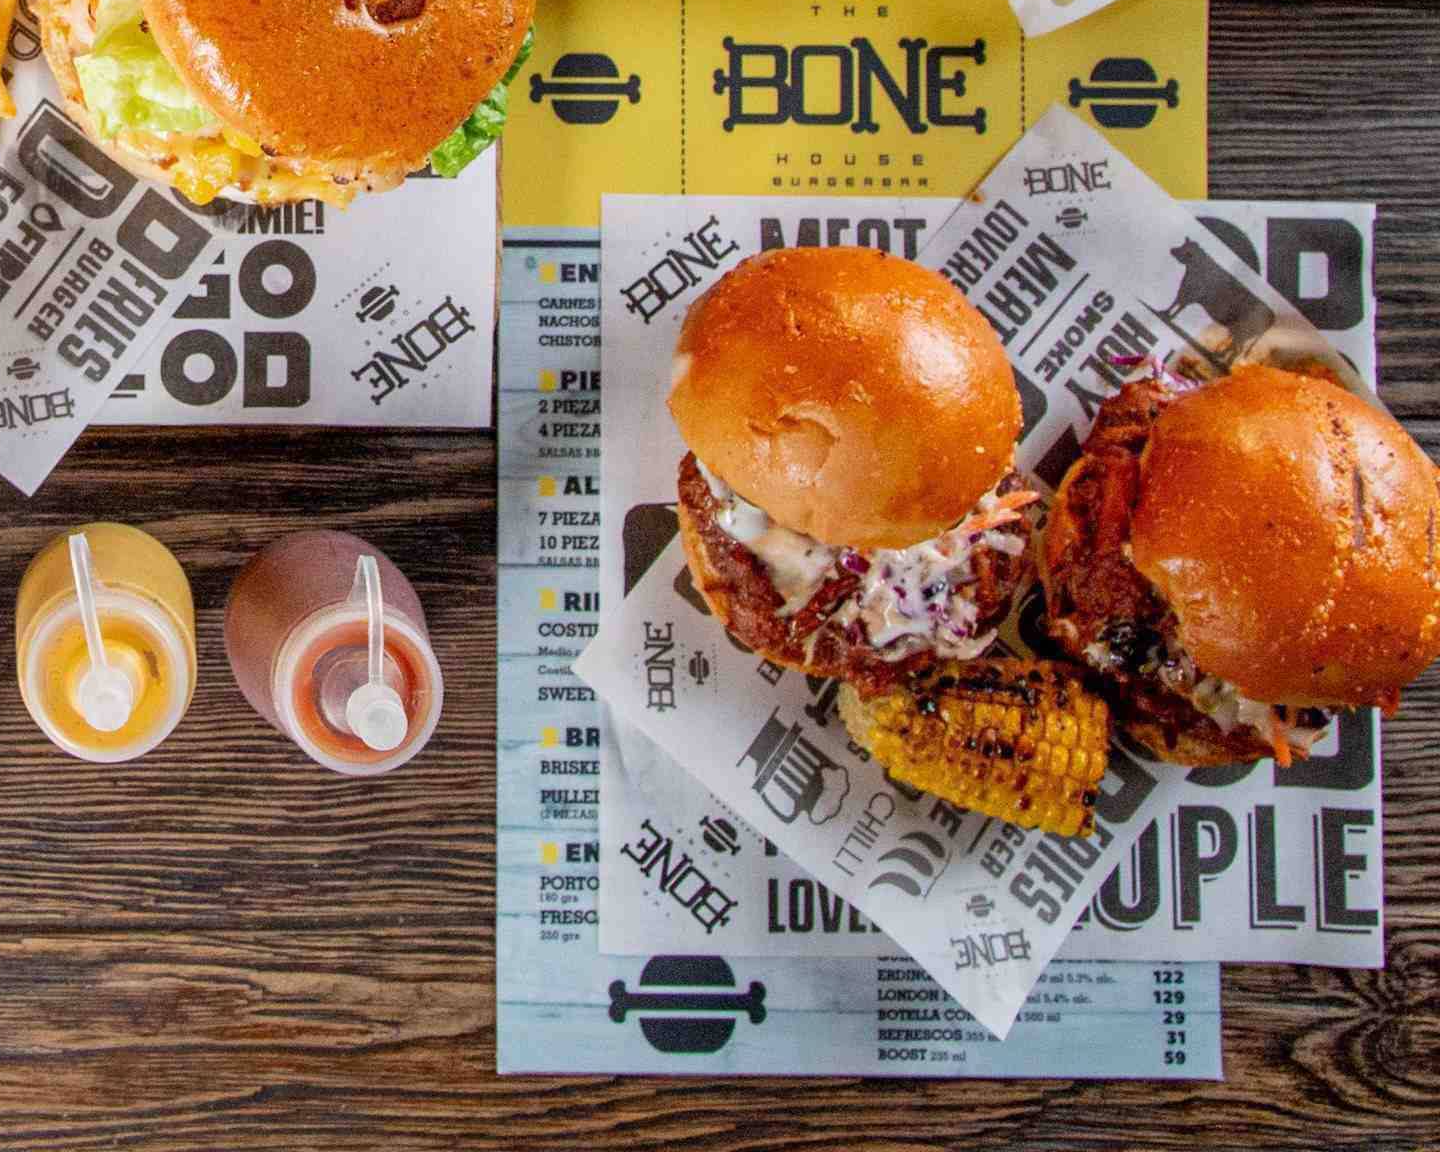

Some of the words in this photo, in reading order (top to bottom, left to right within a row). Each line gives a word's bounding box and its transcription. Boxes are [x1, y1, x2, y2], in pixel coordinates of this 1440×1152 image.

[811, 5, 890, 17] THE
[713, 36, 987, 134] BONE
[776, 153, 925, 166] HOUSE
[772, 177, 929, 187] BURGERBAR
[1023, 160, 1112, 197] BONE
[561, 263, 601, 283] EN
[620, 215, 740, 324] BONE
[27, 237, 115, 341] BURGER
[539, 298, 596, 310] CARNES
[57, 259, 168, 384] FRIES
[1034, 290, 1115, 384] SMOKE
[351, 295, 476, 406] BONE
[538, 400, 548, 414] 2
[538, 423, 548, 438] 4
[538, 512, 548, 526] 7
[539, 535, 557, 550] 10
[644, 621, 677, 713] BONE
[831, 791, 896, 878] CHILLI
[620, 818, 739, 935] BONE
[540, 910, 600, 925] FRESC
[950, 928, 1032, 971] BONE
[1153, 970, 1185, 985] 122
[878, 989, 939, 1002] LONDON
[1153, 990, 1186, 1004] 129
[878, 1009, 940, 1021] BOTELLA
[1163, 1010, 1186, 1025] 29
[878, 1029, 963, 1041] REFRESCOS
[1167, 1030, 1186, 1045] 31
[878, 1048, 927, 1061] BOOST
[1165, 1051, 1186, 1065] 59
